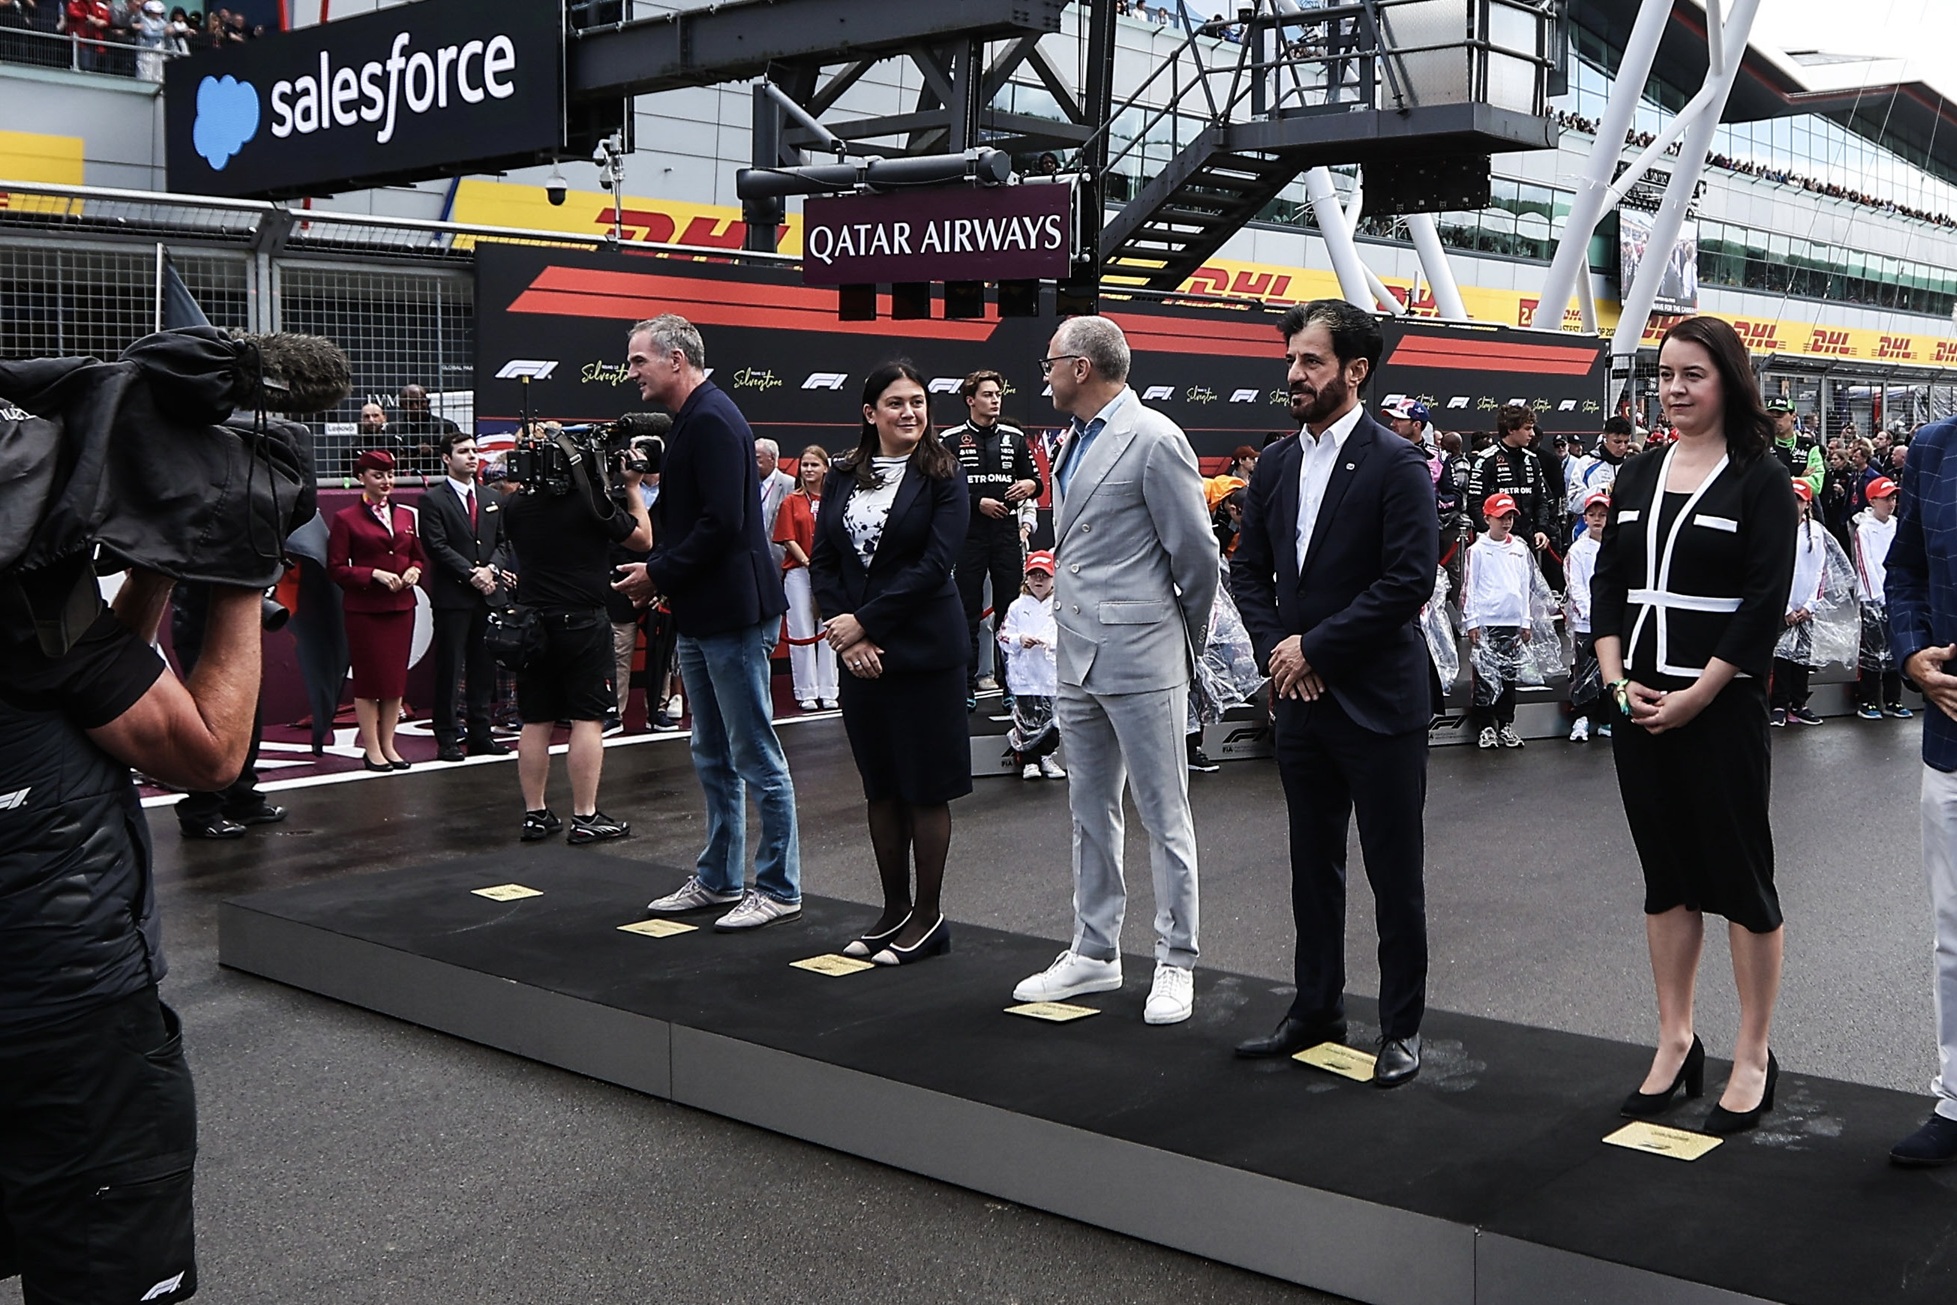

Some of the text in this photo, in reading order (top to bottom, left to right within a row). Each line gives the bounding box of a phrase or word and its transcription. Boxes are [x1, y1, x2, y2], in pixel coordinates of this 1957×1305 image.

[271, 32, 515, 143] salesforce
[809, 214, 1062, 265] QATAR AIRWAYS
[1733, 321, 1777, 349] DHL
[1810, 330, 1851, 354] DHL
[1877, 337, 1912, 359] DHL
[1935, 342, 1957, 361] DH
[494, 360, 559, 379] F1
[581, 360, 629, 387] Silversto
[733, 366, 782, 391] Silverstone
[800, 372, 848, 390] F1
[1141, 385, 1175, 400] F1
[1229, 389, 1259, 403] F1
[1447, 397, 1470, 409] F1
[967, 473, 1012, 484] ETRONAS
[140, 1270, 185, 1301] F1
